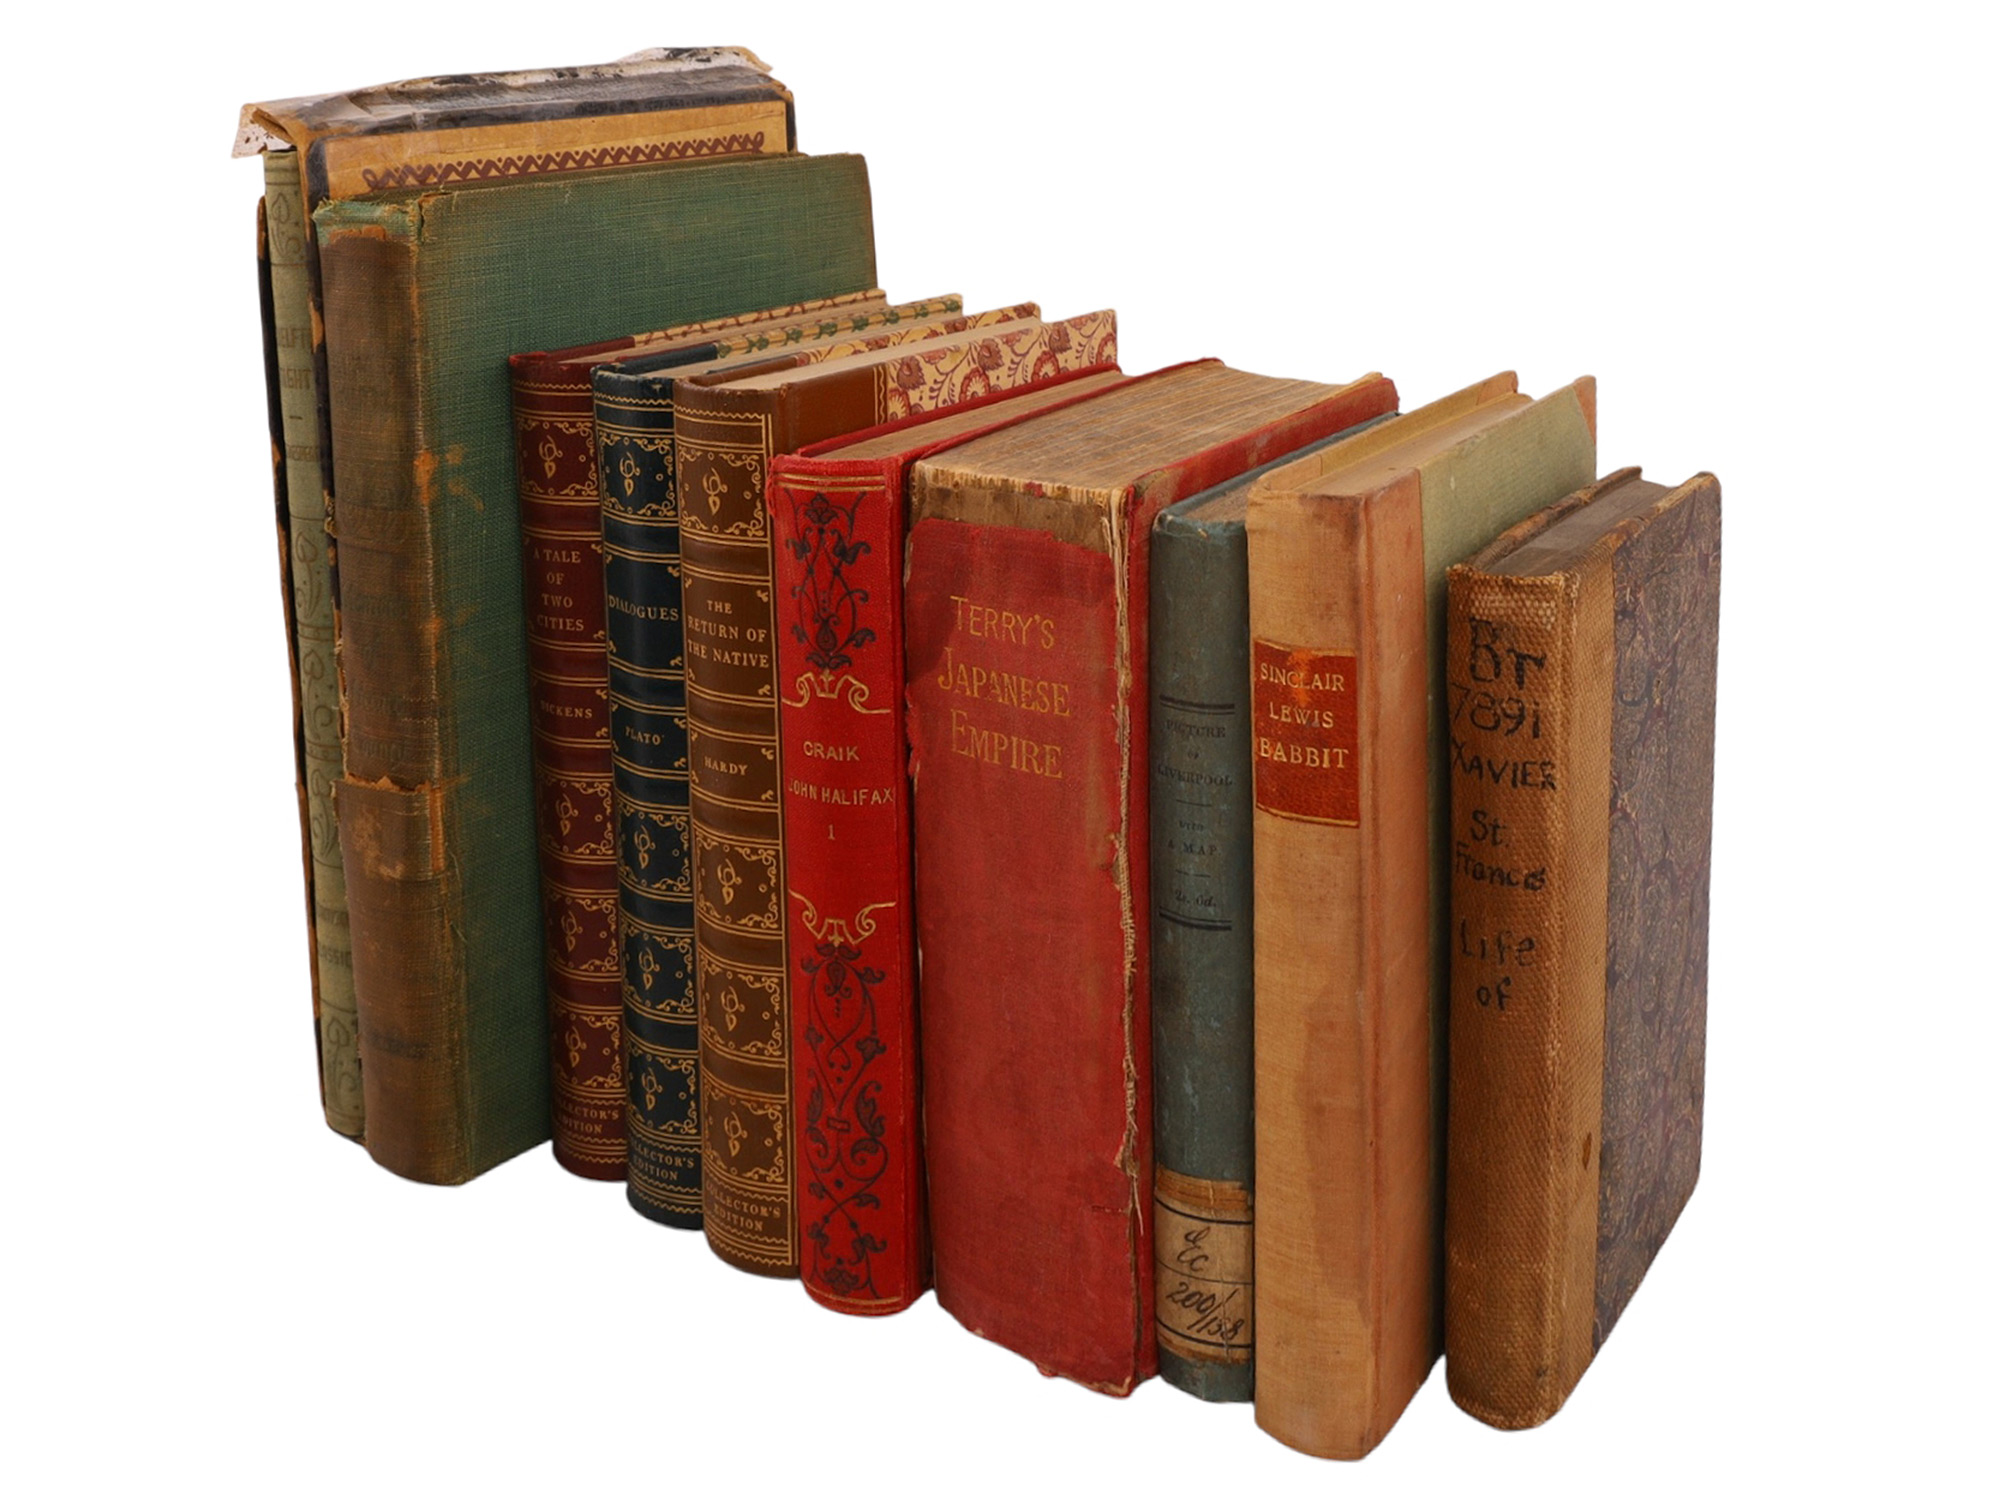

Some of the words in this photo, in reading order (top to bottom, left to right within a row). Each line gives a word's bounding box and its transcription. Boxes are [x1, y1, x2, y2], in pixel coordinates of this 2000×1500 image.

[543, 548, 581, 563] TALE
[546, 571, 565, 585] OF
[541, 592, 573, 609] TWO
[608, 594, 679, 622] DIALOGUES
[707, 600, 733, 615] THE
[536, 614, 584, 632] CITIES
[688, 615, 739, 640] RETURN
[746, 628, 767, 643] OF
[950, 595, 1055, 649] TERRY'S
[688, 639, 707, 659] THE
[713, 648, 769, 669] NATIVE
[937, 647, 1071, 718] JAPANESE
[1260, 662, 1345, 692] SINCLAIR
[1269, 701, 1334, 729] LEWIS
[625, 726, 661, 746] PLATO
[950, 708, 1063, 779] EMPIRE
[803, 741, 860, 761] CRAIK
[1260, 737, 1349, 769] BABBIT
[1452, 736, 1556, 790] XAVIER
[704, 756, 748, 776] HARDY
[789, 779, 817, 801] JOHN
[821, 787, 892, 806] HALIFAX
[1476, 976, 1513, 1011] of
[714, 1203, 763, 1232] EDITION
